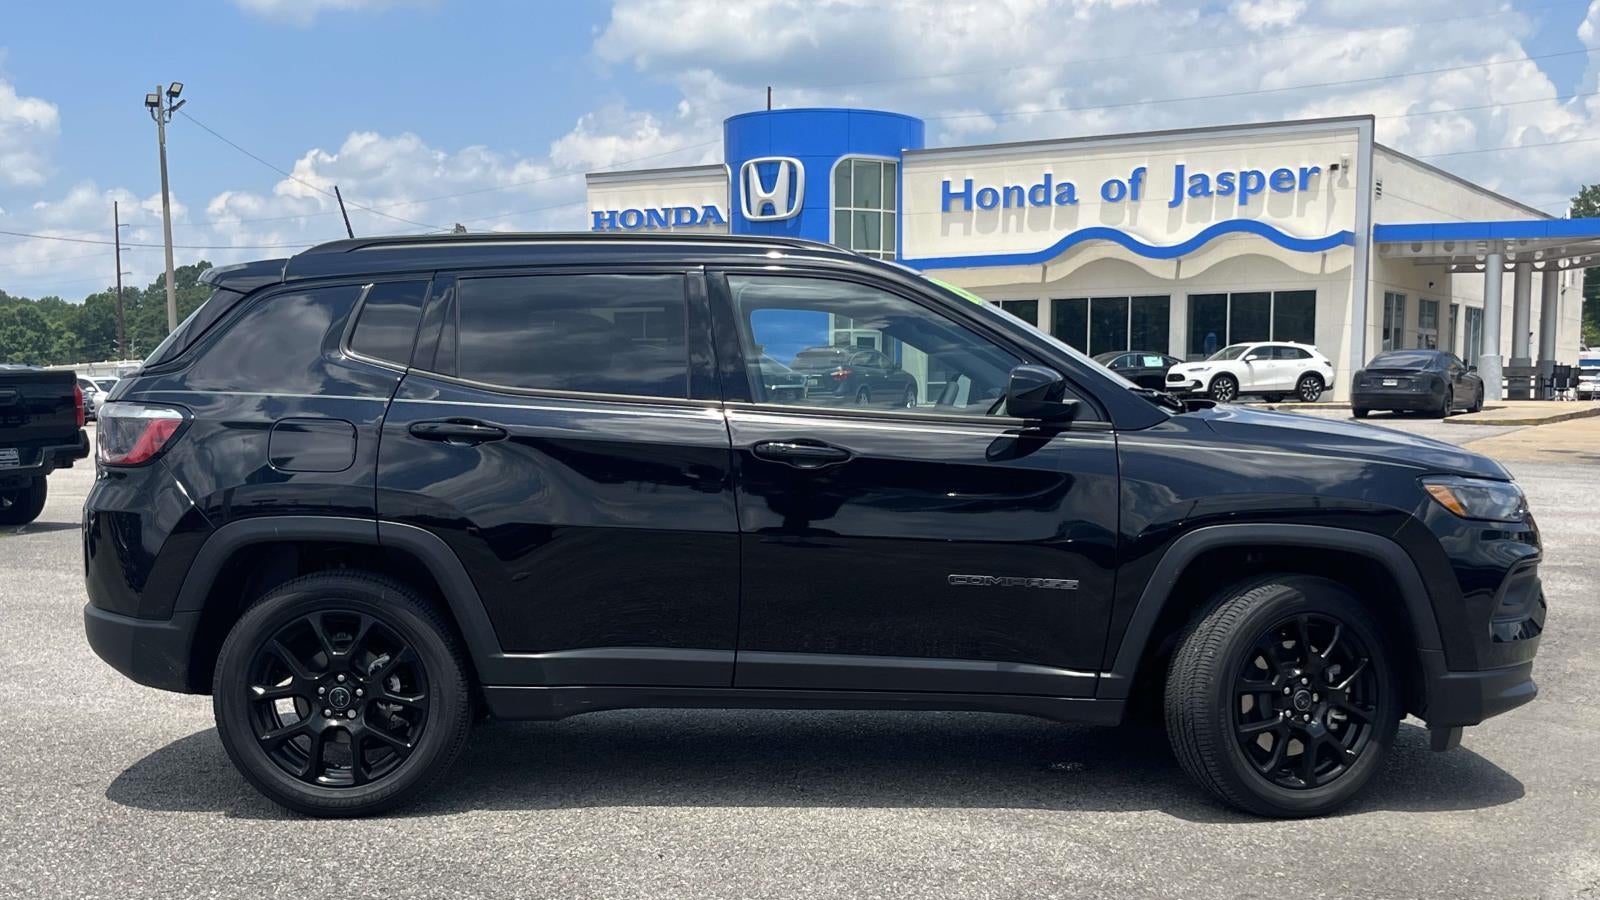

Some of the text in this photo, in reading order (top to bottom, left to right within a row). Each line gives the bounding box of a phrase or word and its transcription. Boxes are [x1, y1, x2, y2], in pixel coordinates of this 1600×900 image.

[941, 164, 1321, 213] Honda of Jasper
[591, 205, 727, 231] HONDA
[948, 574, 1079, 589] COMPASS
